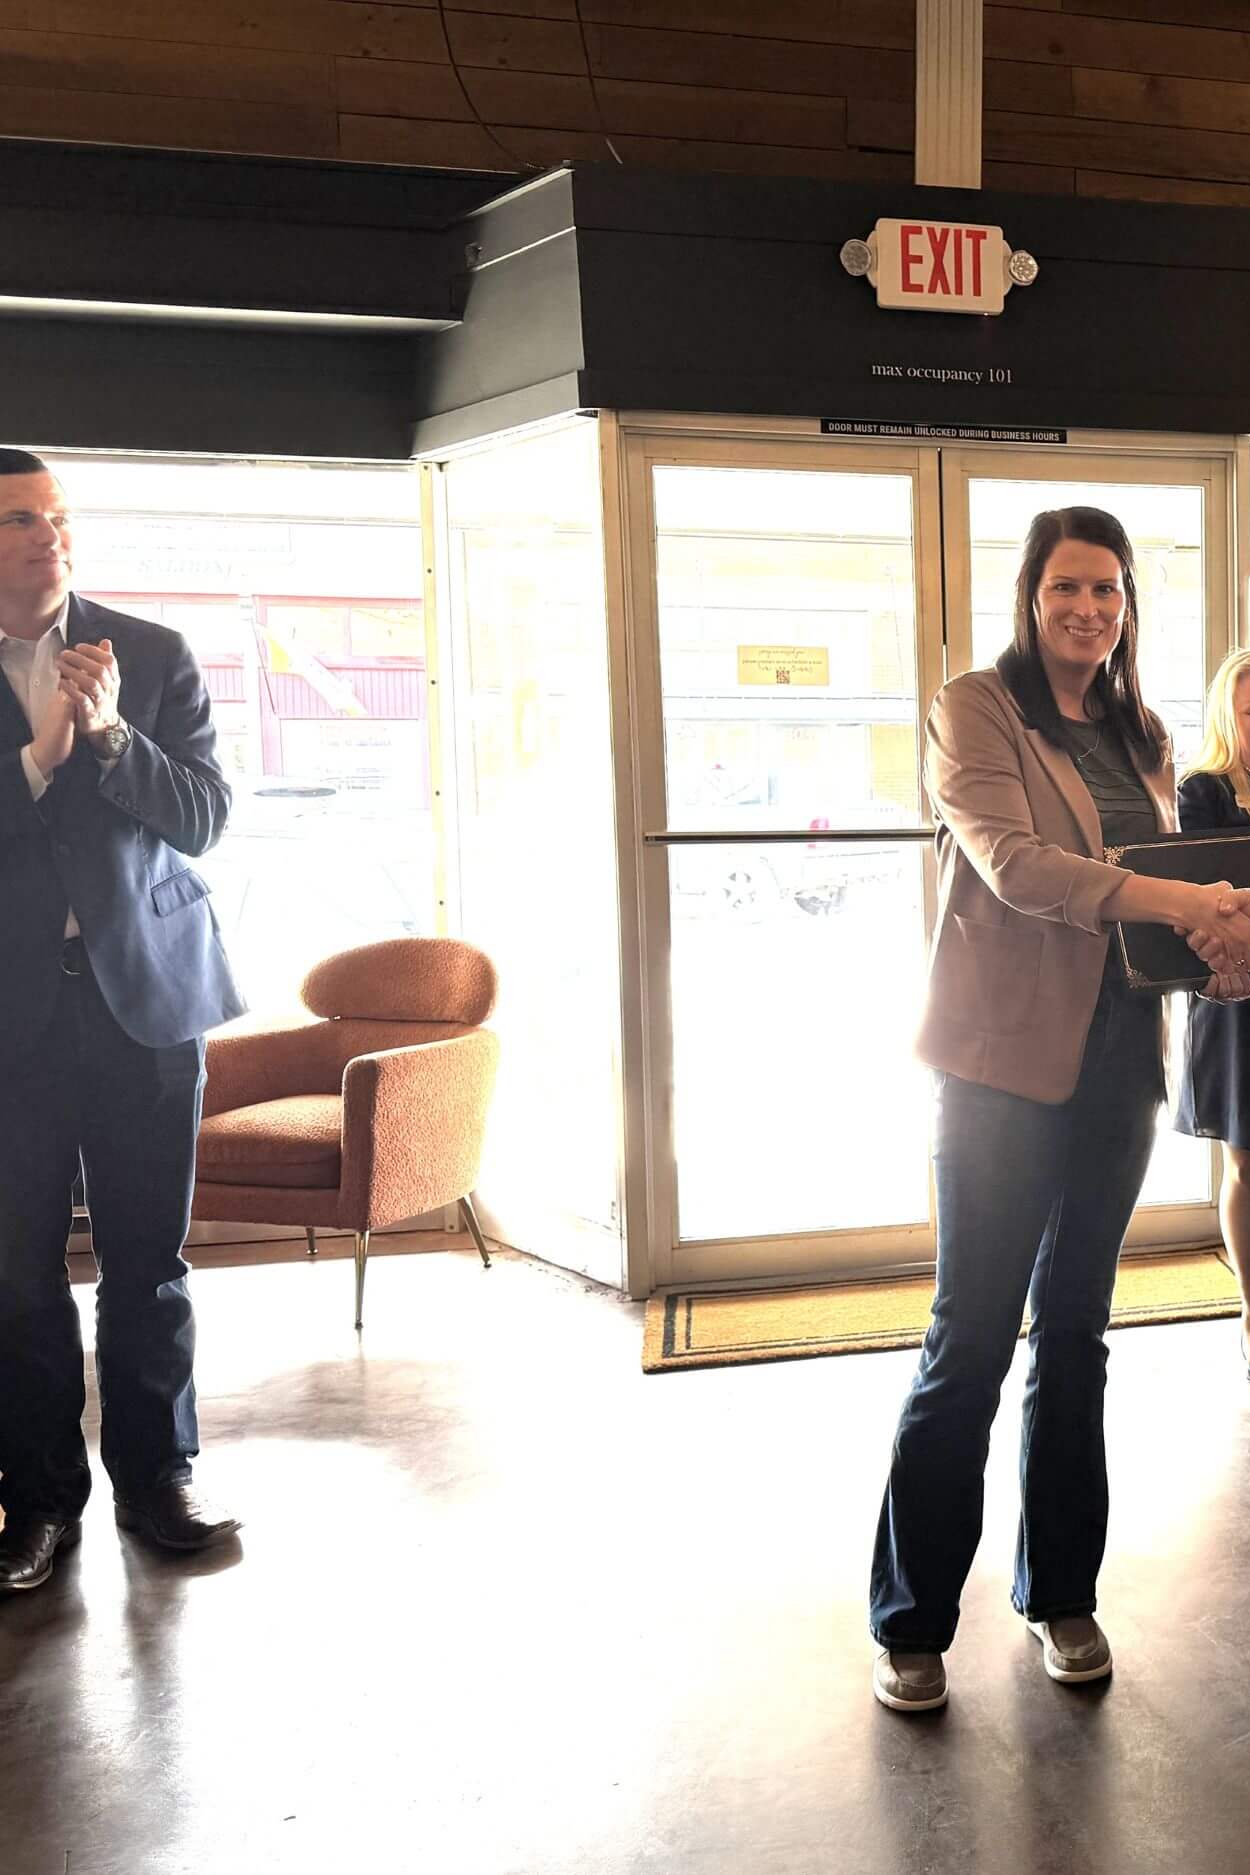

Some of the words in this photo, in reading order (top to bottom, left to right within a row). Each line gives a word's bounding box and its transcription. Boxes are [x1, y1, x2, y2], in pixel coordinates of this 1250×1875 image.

[900, 224, 987, 297] EXIT
[872, 364, 903, 377] max
[906, 367, 983, 384] occupancy
[989, 368, 1011, 383] 101
[828, 423, 852, 432] DOOR
[854, 424, 877, 433] MUST
[880, 425, 912, 435] REMAIN
[914, 427, 957, 437] UNLOCKED
[959, 429, 989, 439] DURING
[991, 431, 1031, 440] BUSINESS
[1032, 432, 1060, 441] HOURS
